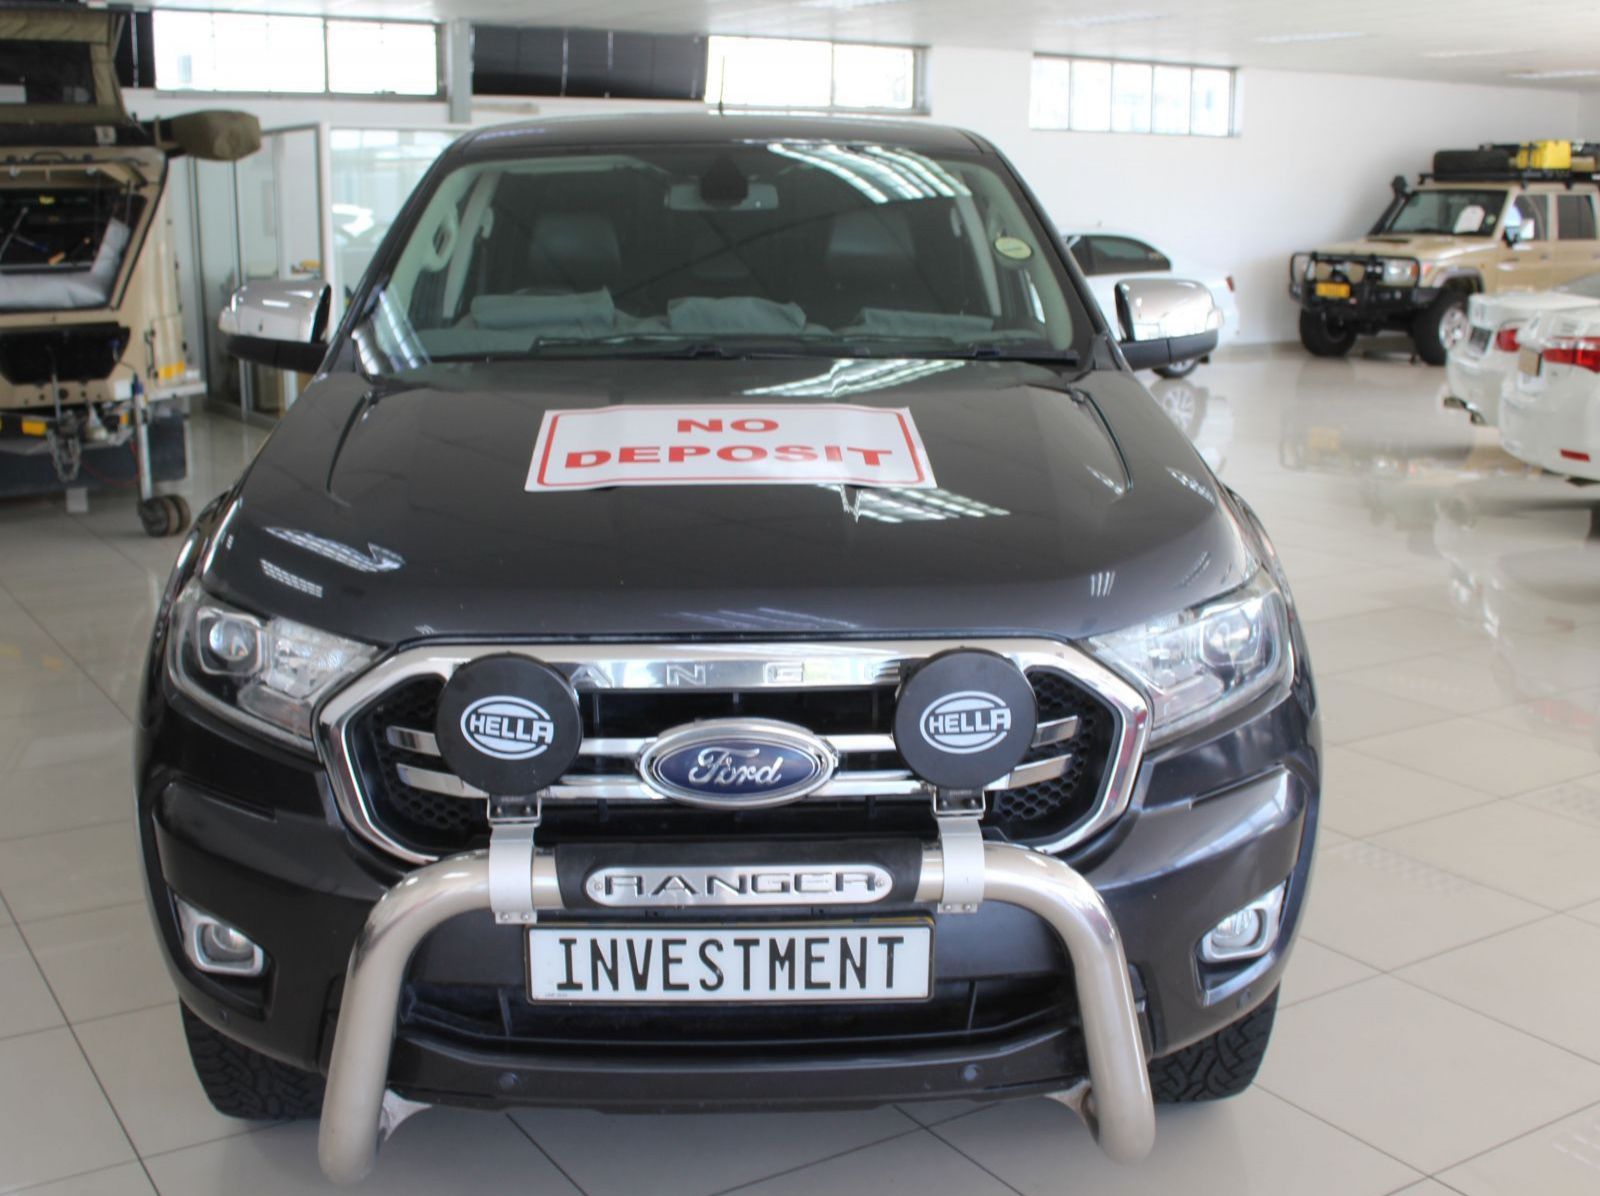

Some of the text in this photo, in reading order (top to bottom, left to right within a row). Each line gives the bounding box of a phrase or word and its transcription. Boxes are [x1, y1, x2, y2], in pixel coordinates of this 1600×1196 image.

[677, 418, 779, 433] NO
[565, 444, 892, 468] DEPOSIT
[469, 713, 554, 745] HELLA
[929, 708, 1011, 734] HELLA
[688, 747, 783, 785] Ford
[604, 872, 876, 896] RANGER
[557, 937, 904, 991] INVESTMENT
